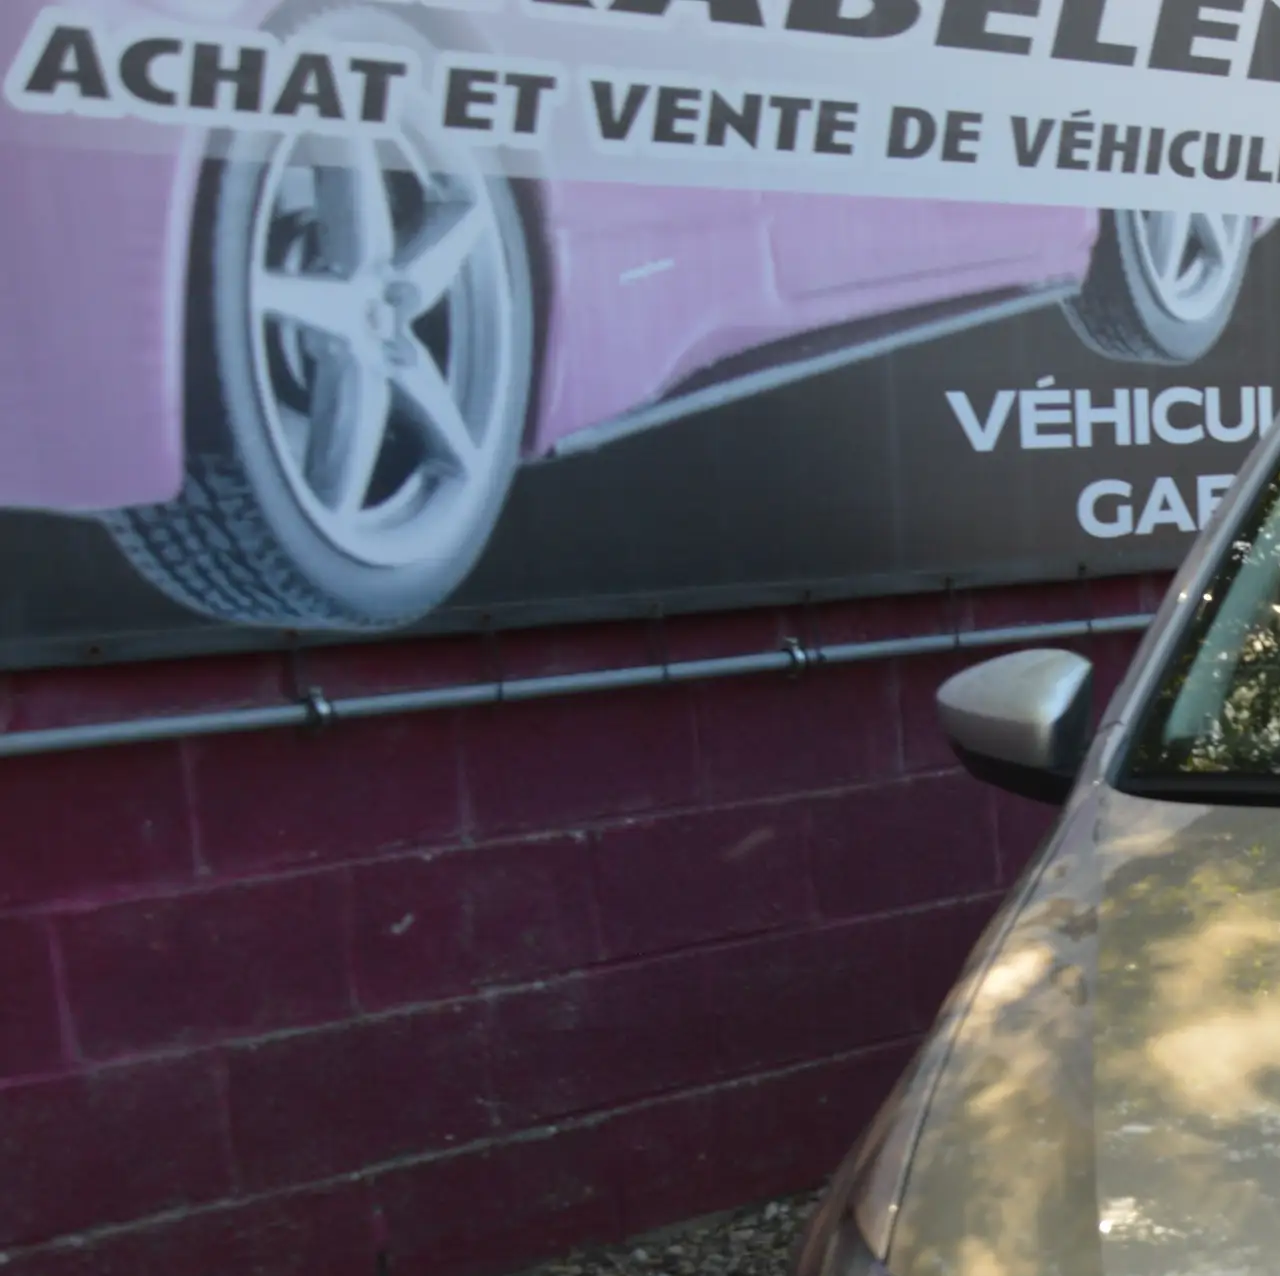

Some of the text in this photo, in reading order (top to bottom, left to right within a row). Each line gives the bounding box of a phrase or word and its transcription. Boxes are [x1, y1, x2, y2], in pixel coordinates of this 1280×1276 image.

[23, 25, 407, 122] ACHAT
[443, 67, 558, 134] ET
[589, 80, 859, 155] VENTE
[885, 106, 984, 163] DE
